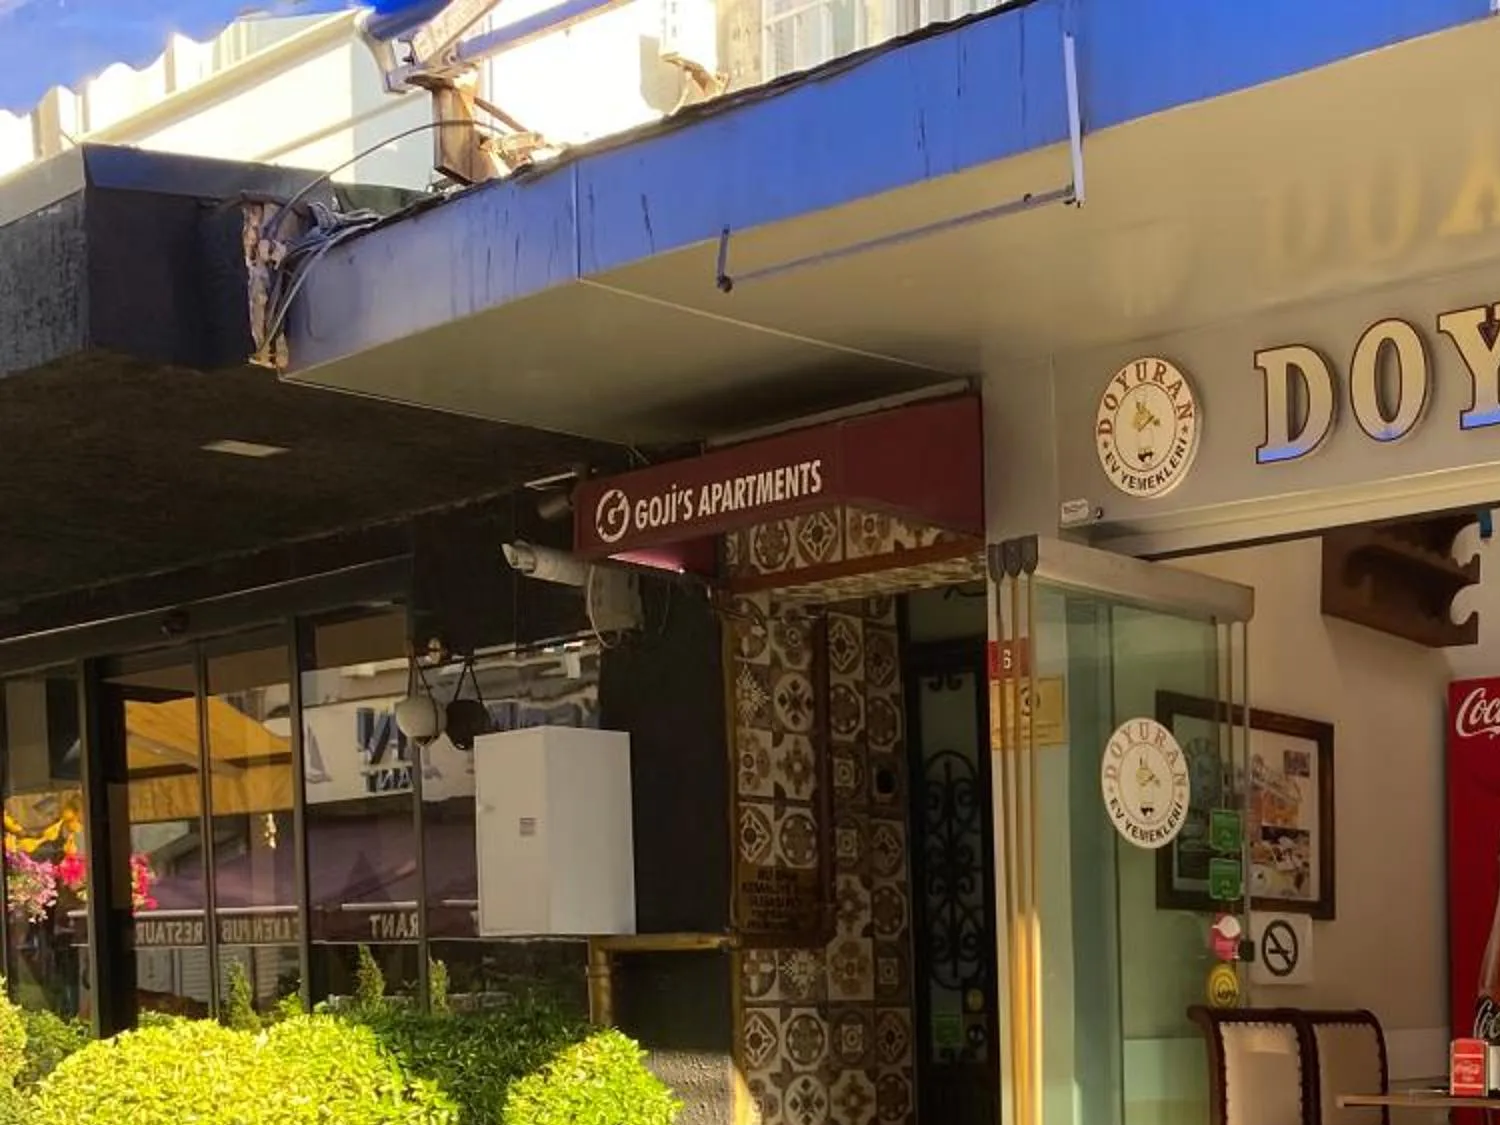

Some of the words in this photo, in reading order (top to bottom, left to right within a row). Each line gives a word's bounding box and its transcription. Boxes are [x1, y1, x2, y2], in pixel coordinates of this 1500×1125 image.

[1097, 360, 1193, 436] DOYURAN
[697, 458, 823, 518] APARTMENTS
[1105, 451, 1121, 474] EV
[1104, 721, 1188, 788] DOYURAN
